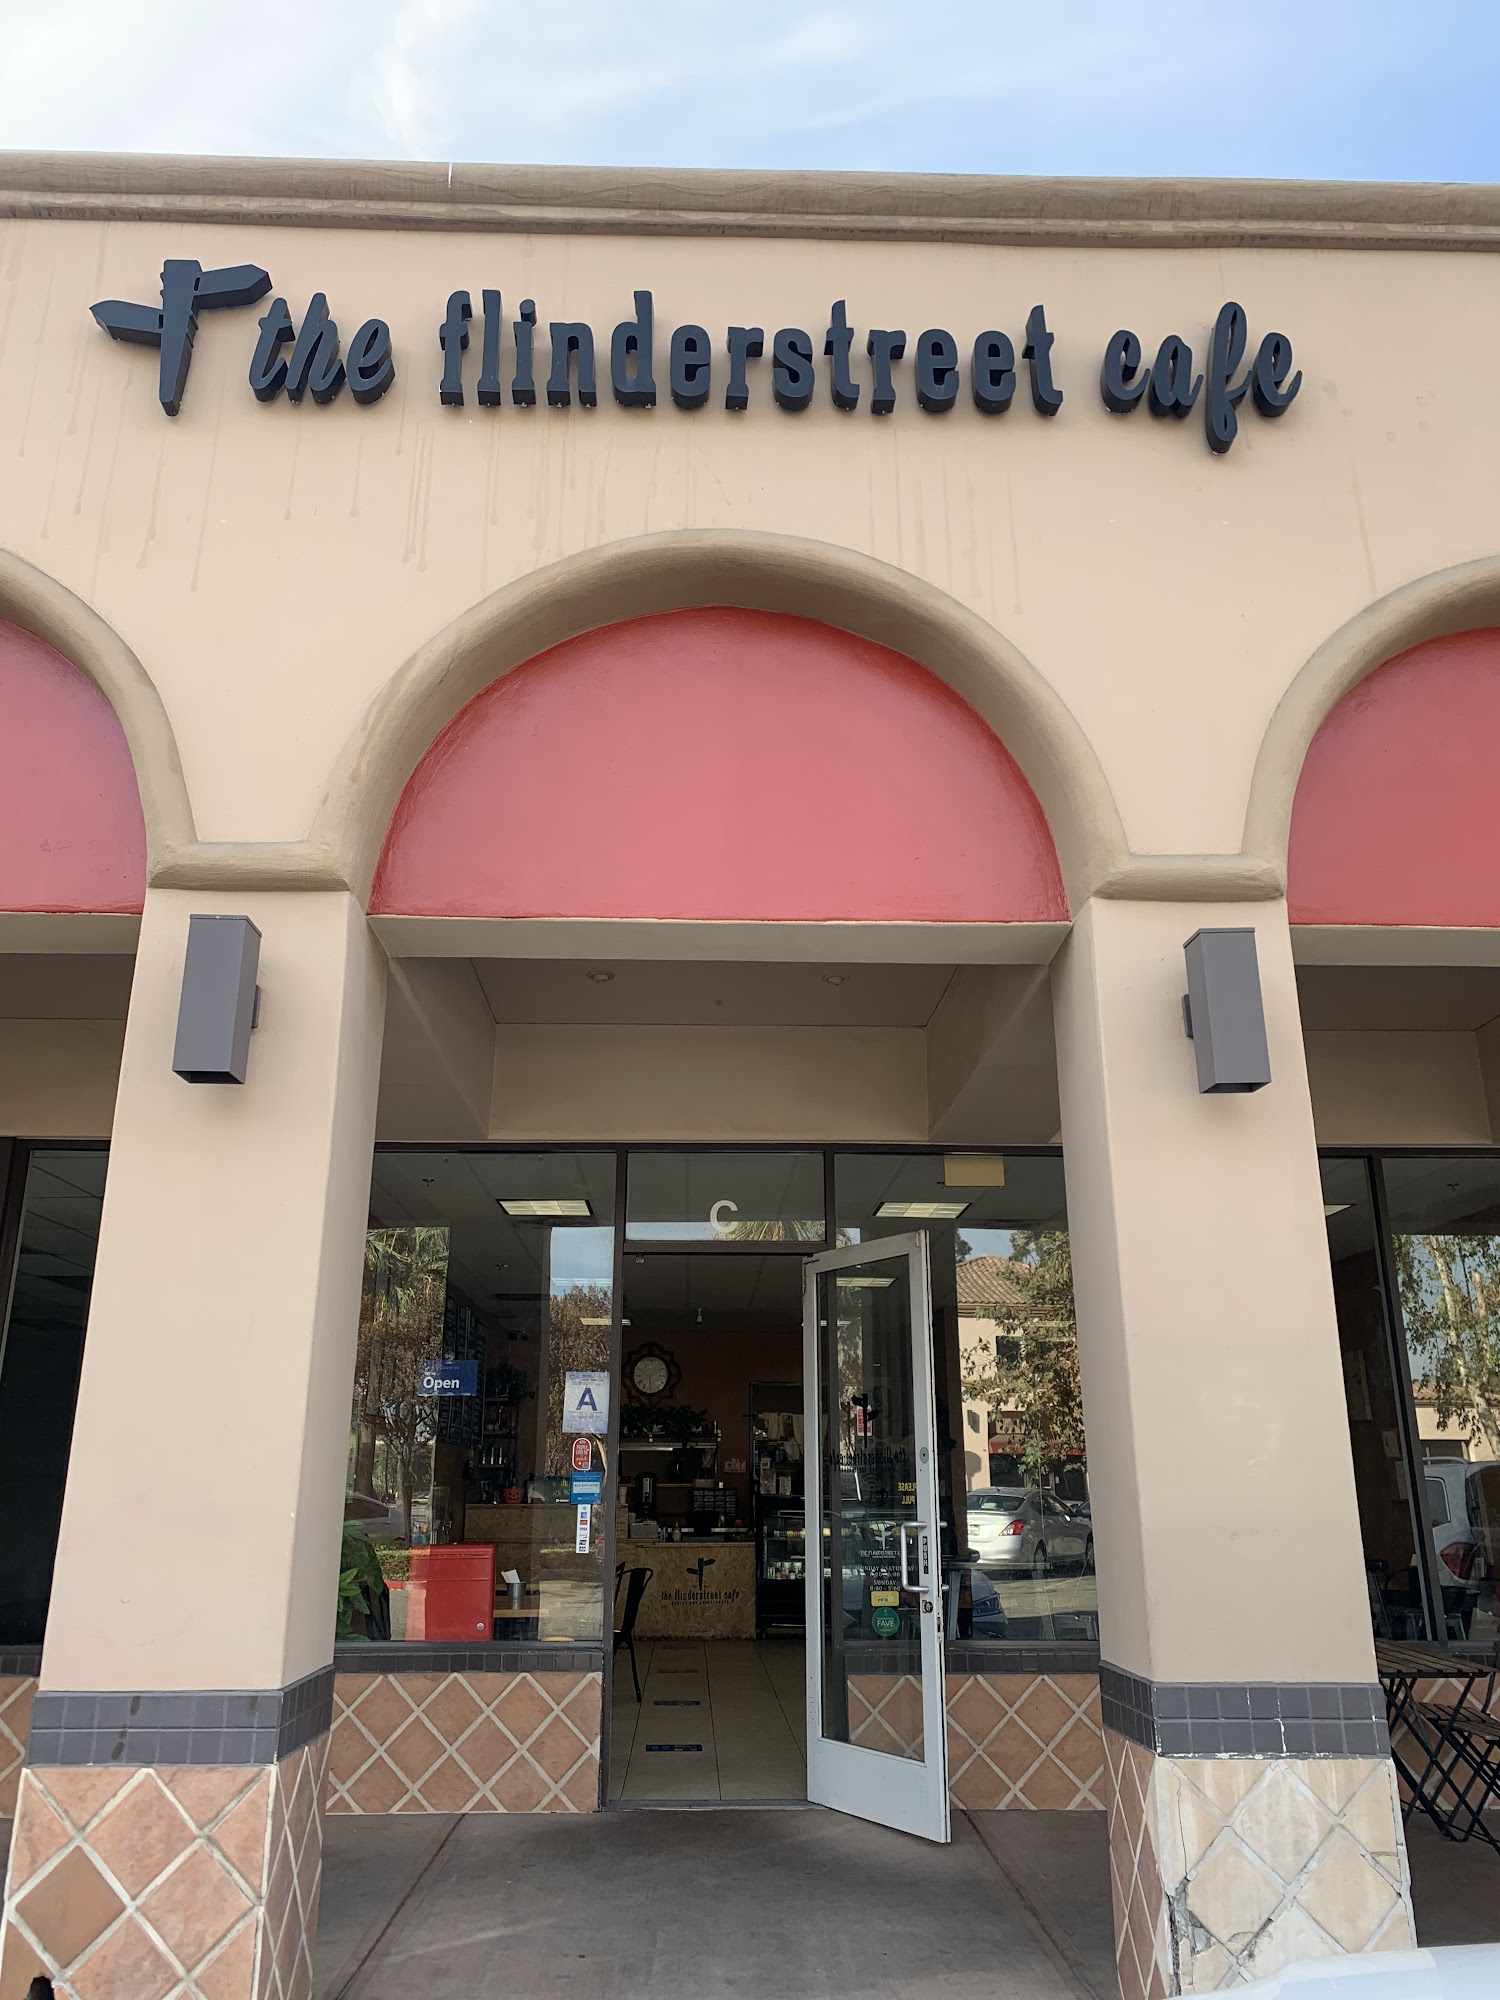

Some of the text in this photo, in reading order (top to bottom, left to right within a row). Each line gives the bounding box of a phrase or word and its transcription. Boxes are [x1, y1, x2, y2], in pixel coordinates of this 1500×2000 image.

[248, 290, 1303, 454] the flinderstreet cafe
[710, 1200, 738, 1233] C
[423, 1377, 460, 1391] Open
[576, 1387, 597, 1411] A
[660, 1588, 739, 1602] the flinderstreet cafe
